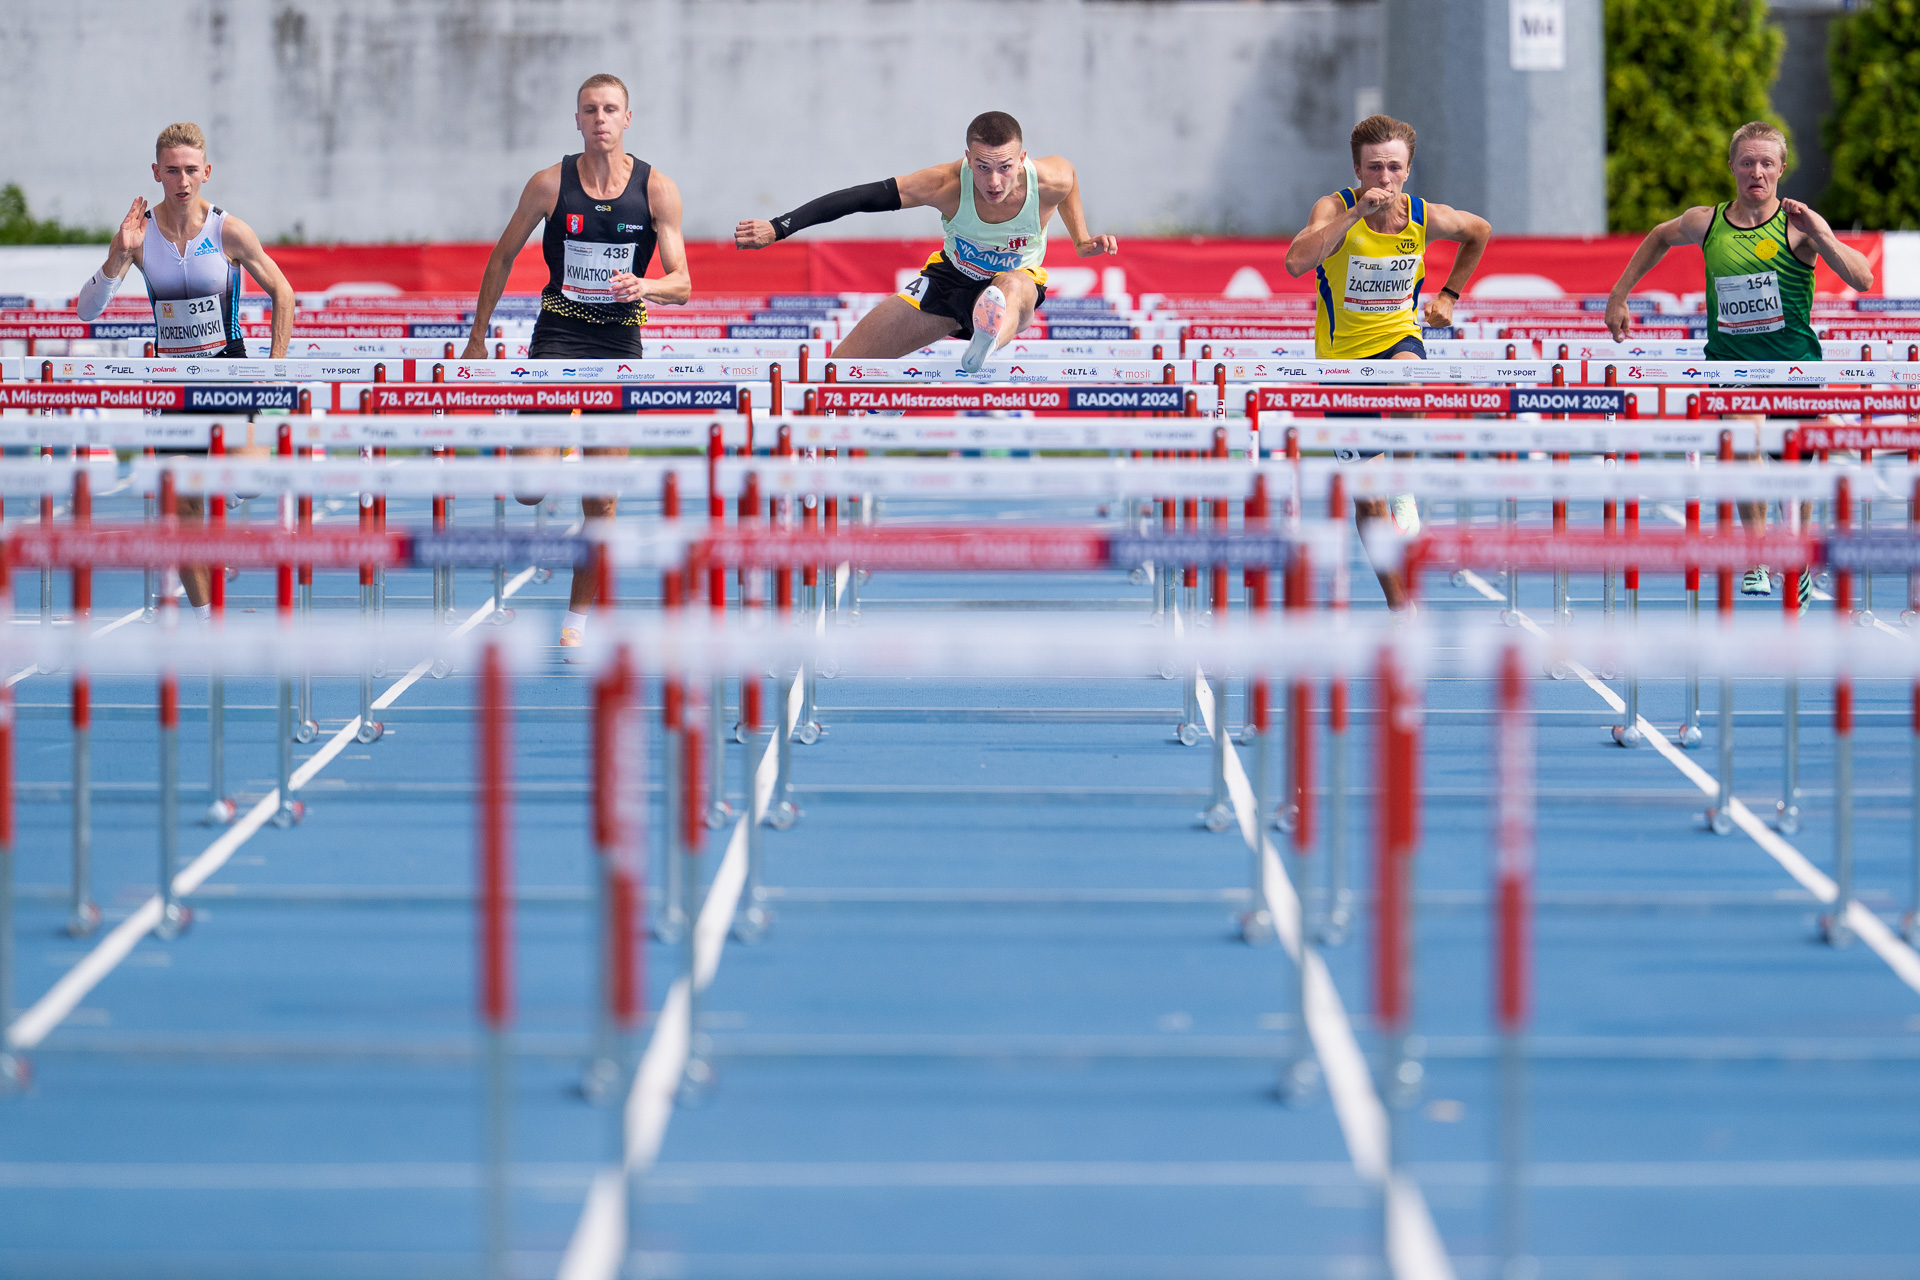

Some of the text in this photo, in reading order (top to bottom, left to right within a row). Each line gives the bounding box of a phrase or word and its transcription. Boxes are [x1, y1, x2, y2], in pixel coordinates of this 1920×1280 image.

[595, 204, 611, 212] esa
[194, 248, 219, 256] adidas
[603, 248, 629, 259] 438
[1390, 258, 1416, 272] 207
[904, 278, 924, 296] 4
[1746, 276, 1772, 290] 154
[189, 300, 215, 314] 312
[1720, 296, 1778, 316] WODECKI
[29, 324, 60, 338] Polski
[62, 325, 84, 338] U20
[95, 325, 140, 338] RADOM
[160, 320, 221, 340] KORZENIOWSKI
[347, 326, 379, 338] Polski
[380, 326, 402, 338] U20
[414, 326, 458, 338] RADOM
[732, 326, 777, 338] RADOM
[1052, 327, 1098, 340] RADOM
[1244, 327, 1308, 340] Mistrzostwa
[410, 347, 433, 356] mosir
[937, 350, 953, 358] mpk
[1826, 348, 1851, 356] mosir
[457, 366, 474, 379] 25.
[532, 370, 549, 378] mpk
[578, 366, 604, 374] wodociągi
[732, 366, 759, 375] mosir
[849, 366, 866, 379] 25.
[925, 370, 942, 378] mpk
[970, 372, 992, 380] miejskie
[1068, 368, 1088, 376] RLTL
[1284, 368, 1308, 376] FUEL
[1628, 366, 1645, 379] 25.
[1704, 370, 1720, 378] mpk
[1009, 374, 1048, 382] administrator
[12, 390, 97, 404] Mistrzostwa
[101, 391, 142, 404] Polski
[146, 392, 175, 405] U20
[193, 392, 252, 405] RADOM
[256, 392, 291, 405] 2024
[380, 391, 731, 405] 78. PZLA Mistrzostwa Polski U20 RADOM 2024
[825, 393, 1178, 406] 78. PZLA Mistrzostwa Polski U20 RADOM 2024
[1266, 394, 1618, 409] 78. PZLA Mistrzostwa Polski U20 RADOM 2024
[1706, 397, 1728, 411] 78.
[1732, 397, 1770, 410] PZLA
[1773, 396, 1861, 410] Mistrzostwa
[1864, 396, 1906, 409] Polski
